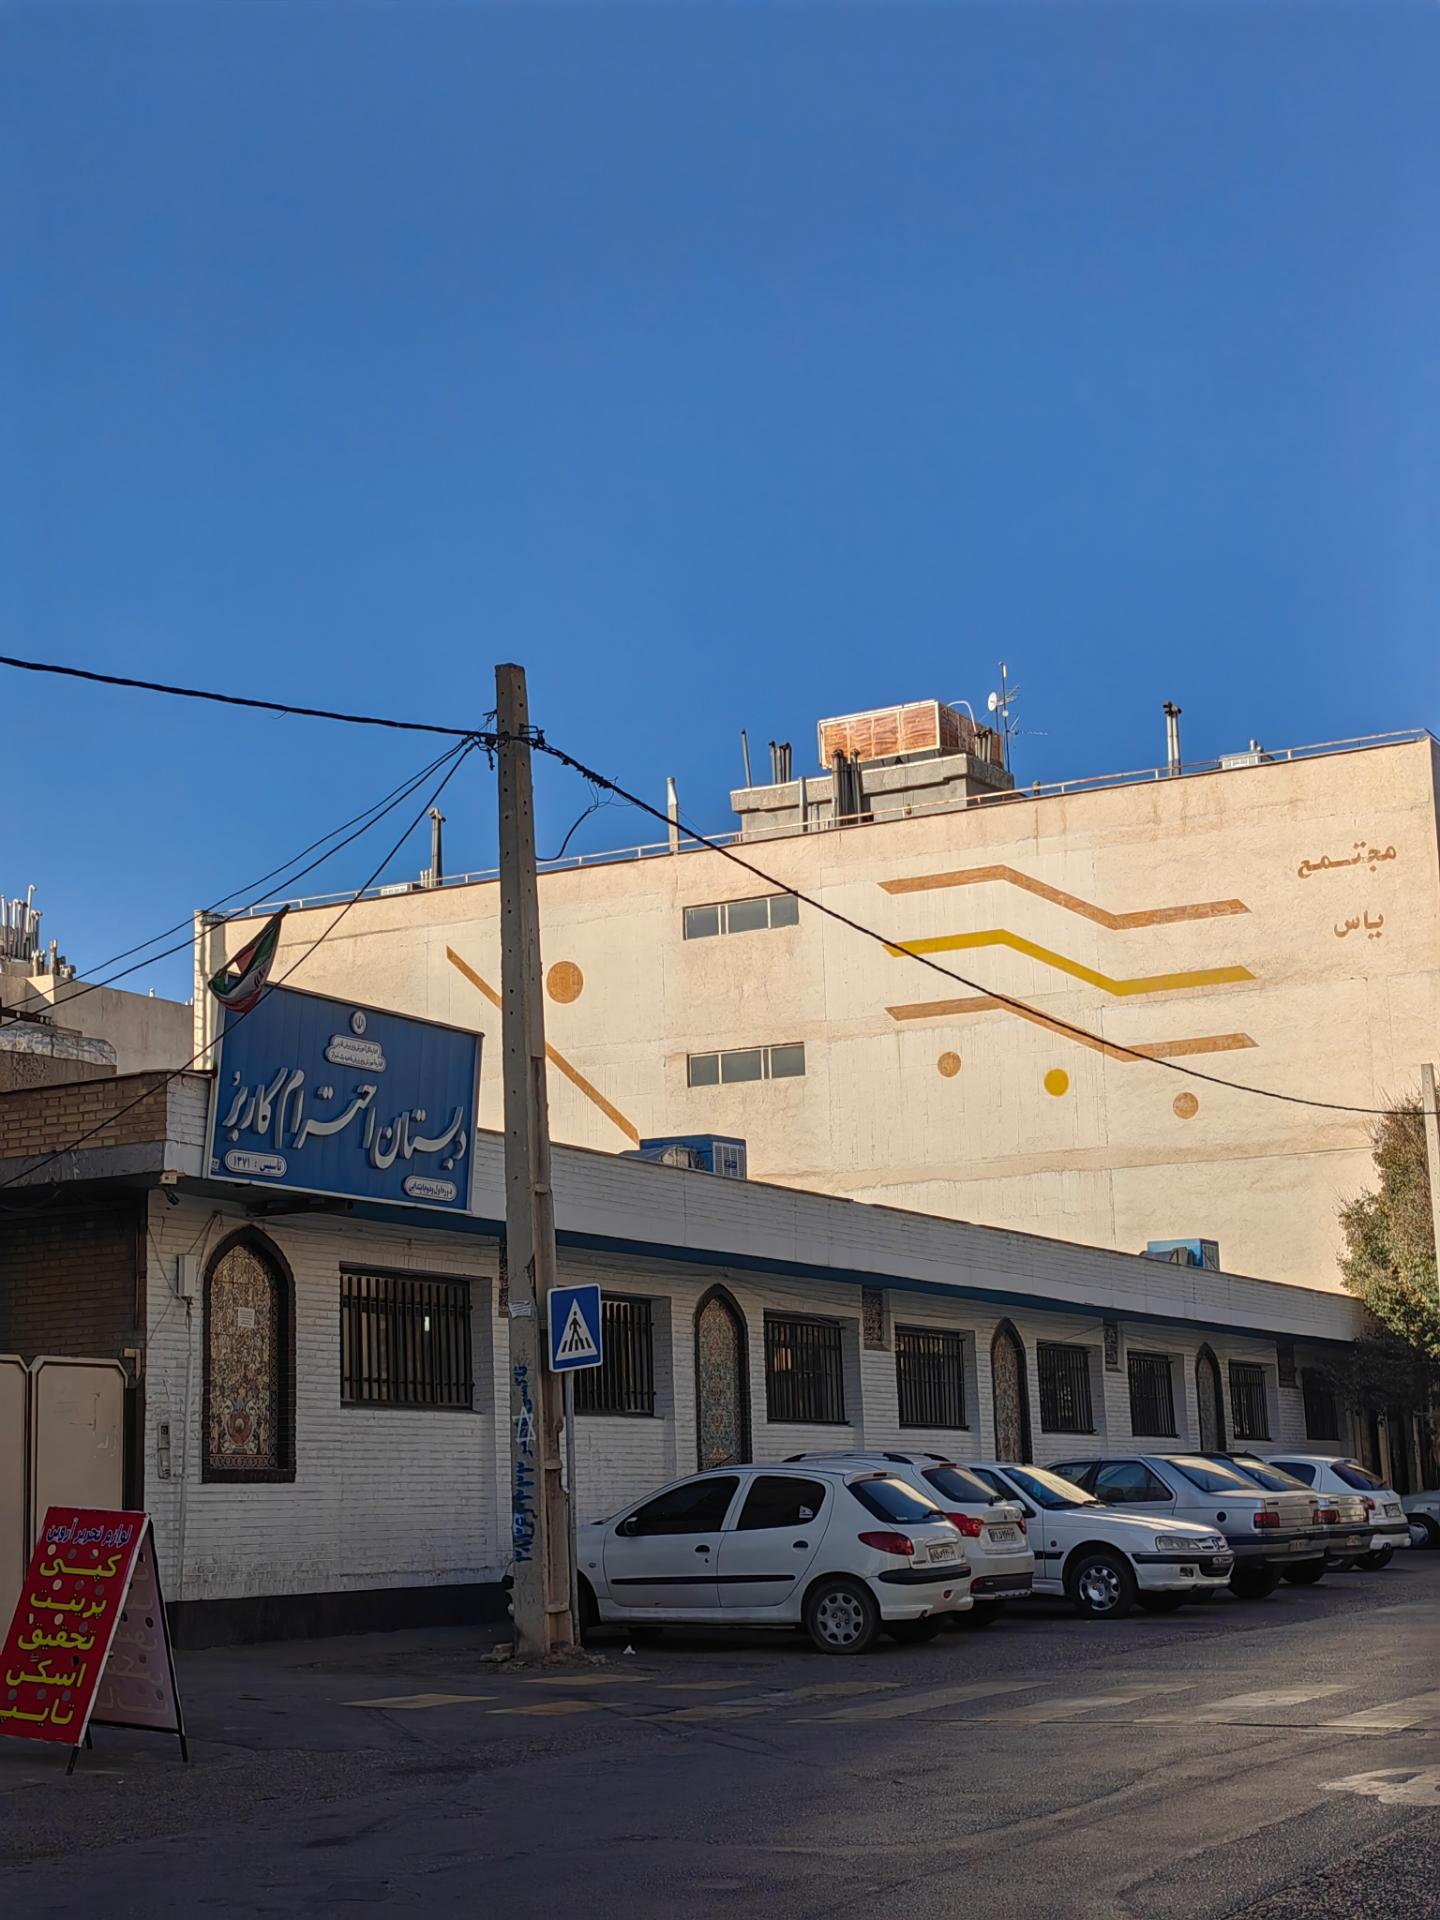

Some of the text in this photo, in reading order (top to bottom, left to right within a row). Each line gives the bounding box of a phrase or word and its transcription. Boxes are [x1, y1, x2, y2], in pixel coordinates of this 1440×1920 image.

[1297, 841, 1397, 879] مجتمع
[1333, 910, 1384, 939] یاس
[275, 1069, 377, 1149] احترام
[370, 1105, 467, 1170] دبستان
[72, 1525, 105, 1545] تحریر
[100, 1523, 133, 1548] لوازم
[39, 1553, 123, 1581] کپی
[30, 1589, 106, 1618] پرینت
[17, 1625, 97, 1650] تحقیق
[5, 1660, 87, 1688] اسکن
